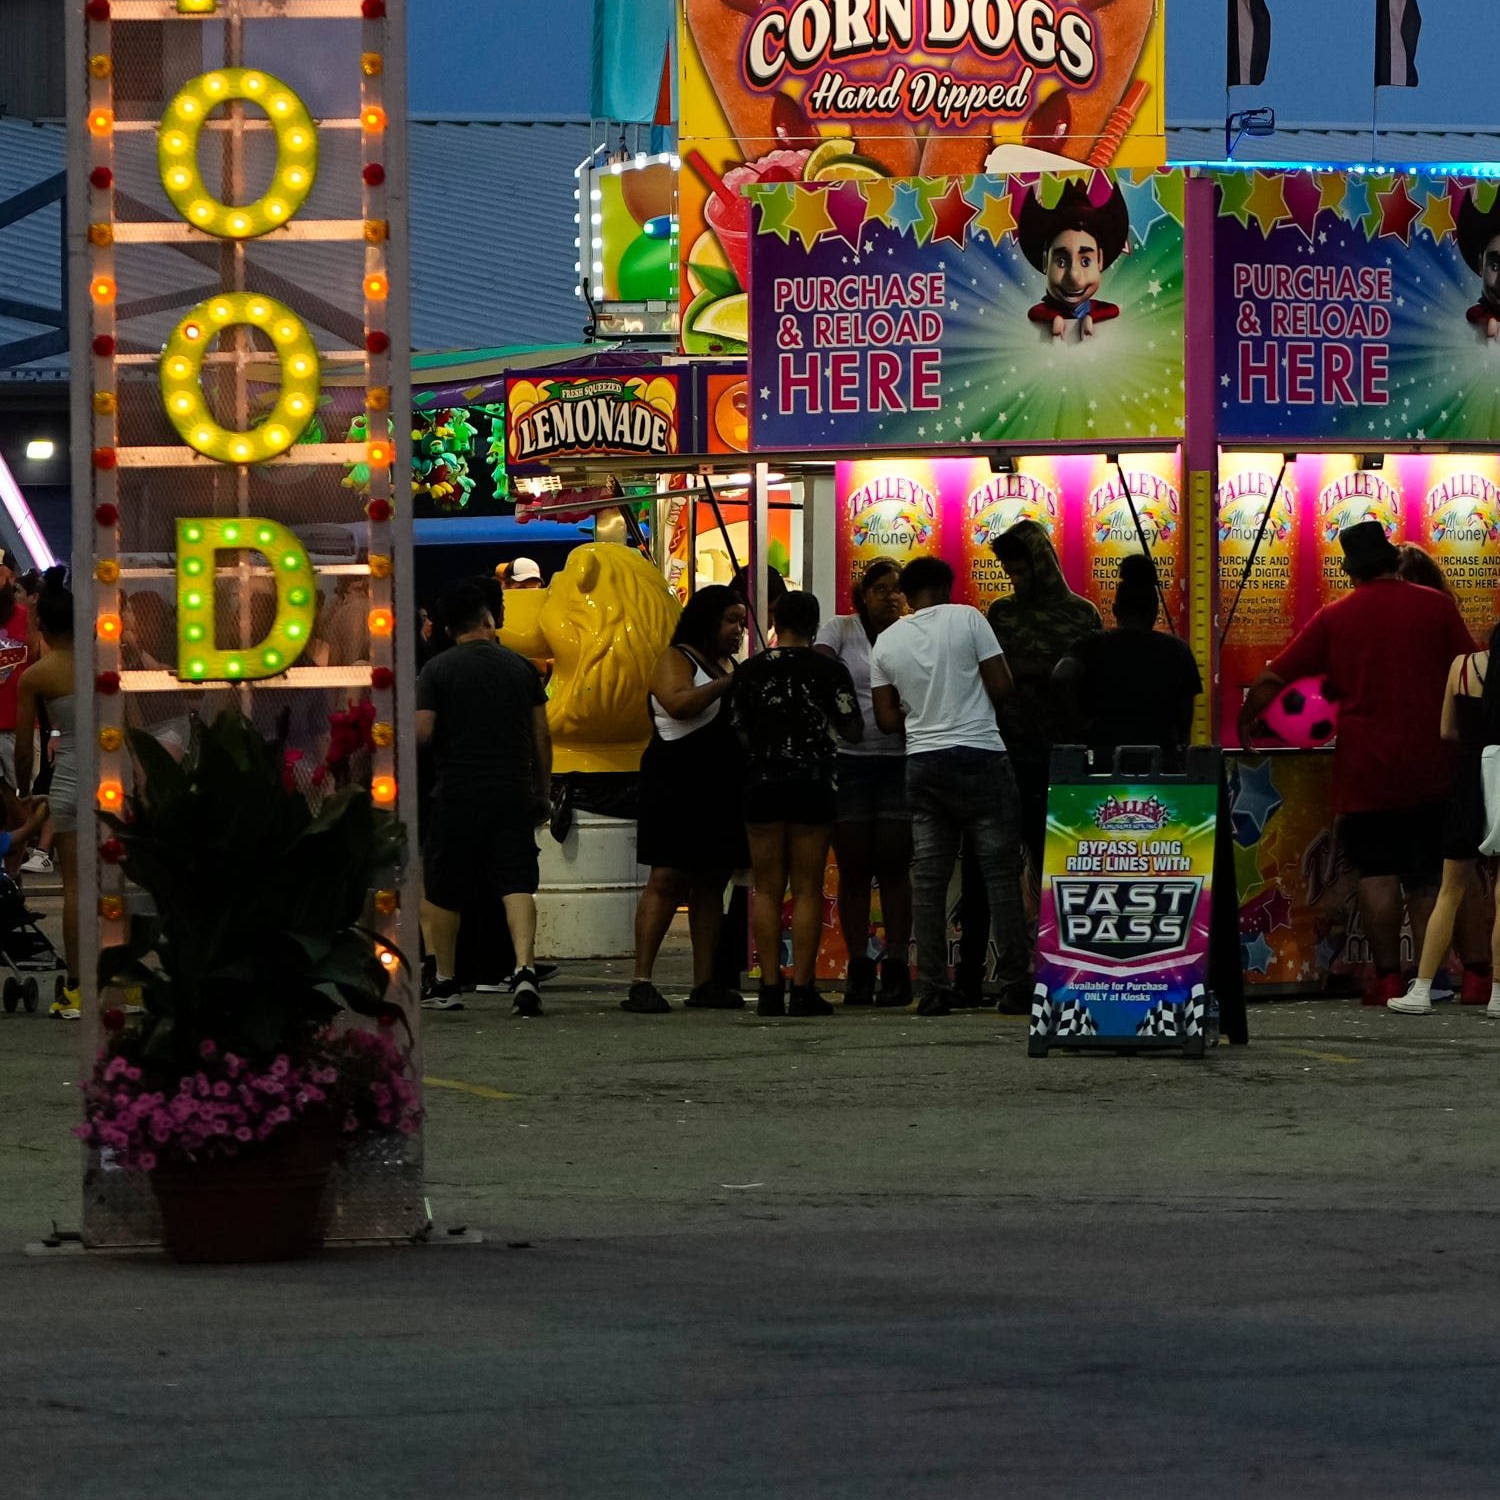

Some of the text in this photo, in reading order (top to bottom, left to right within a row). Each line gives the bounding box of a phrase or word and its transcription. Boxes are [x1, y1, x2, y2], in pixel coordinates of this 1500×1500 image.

[813, 67, 1033, 119] Hand Dipped
[1234, 263, 1392, 302] PURCHASE
[774, 272, 945, 312] PURCHASE
[1236, 300, 1392, 339] & RELOAD
[777, 310, 943, 349] & RELOAD
[779, 349, 941, 414] HERE
[1239, 341, 1389, 405] HERE
[562, 382, 622, 398] FRESH SQUEEZED
[520, 399, 667, 455] LEMONADE
[849, 476, 936, 519] TALLEY'S
[971, 475, 1057, 517] TALLEY'S
[1322, 472, 1399, 515] TALLEY'S
[868, 533, 916, 550] money
[1111, 528, 1159, 546] money
[1232, 528, 1276, 546] money
[1446, 529, 1488, 547] money
[1270, 556, 1290, 566] AND
[1437, 556, 1480, 565] URCHASE
[1093, 569, 1118, 579] RELO
[1255, 568, 1291, 578] DIGITAL
[1323, 568, 1350, 577] RELO
[978, 583, 1011, 592] TICKET
[1221, 580, 1286, 589] TICKETS HERE
[1329, 580, 1354, 589] TICKE
[1475, 580, 1498, 589] HERE
[1078, 840, 1181, 855] BYPASS LONG
[1067, 856, 1191, 871] RIDE LINES WITH
[1060, 884, 1195, 915] FAST
[1066, 915, 1184, 943] PASS
[1069, 982, 1168, 990] Available for Purchase
[1084, 993, 1150, 1001] ONLY at Kiosks
